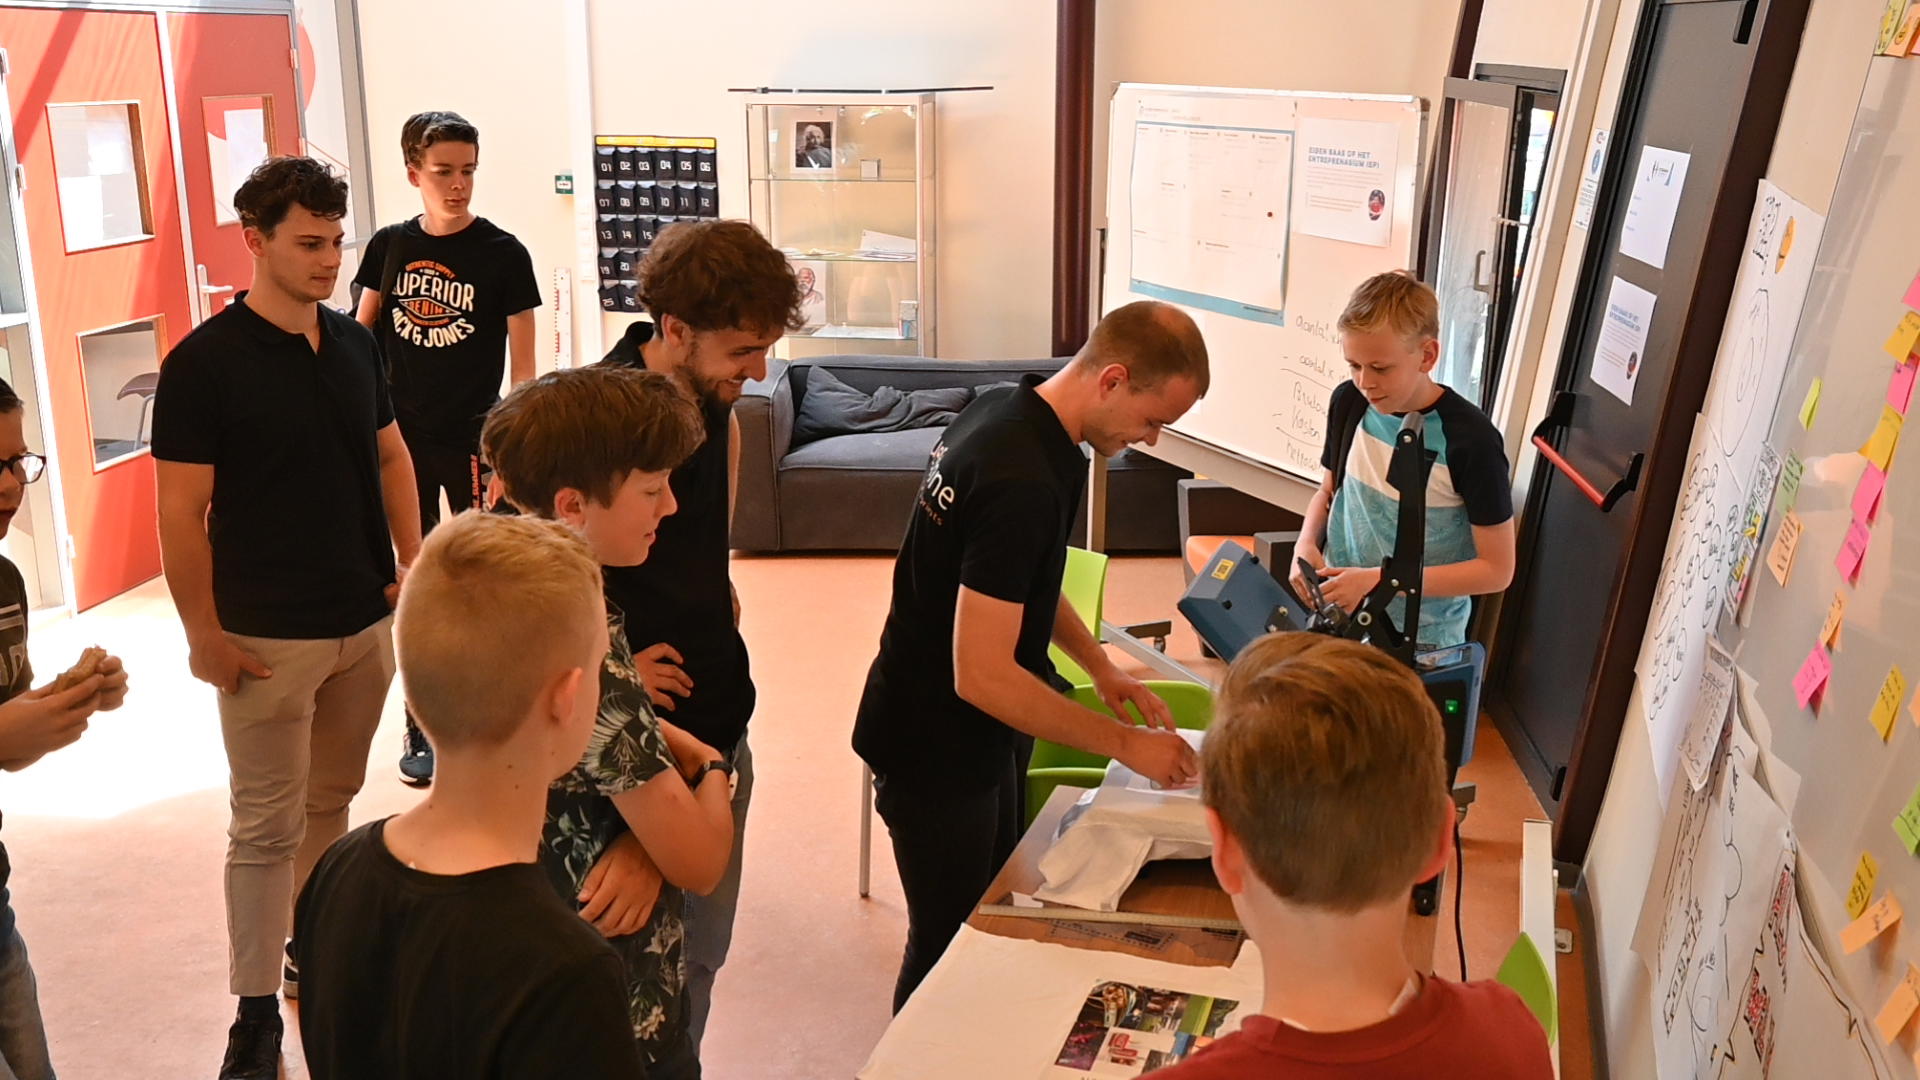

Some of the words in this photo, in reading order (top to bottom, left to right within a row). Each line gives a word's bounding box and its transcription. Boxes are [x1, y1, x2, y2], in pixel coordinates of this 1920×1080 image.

[601, 162, 612, 172] 01
[620, 161, 631, 170] 02
[638, 161, 650, 171] 03
[660, 160, 672, 170] 04
[680, 160, 692, 171] 05
[700, 162, 711, 172] 06
[599, 198, 610, 207] 07
[661, 197, 670, 207] 10
[680, 197, 689, 207] 11
[701, 197, 710, 207] 12
[601, 230, 612, 240] 13
[622, 230, 632, 240] 14
[643, 230, 653, 240] 15
[600, 265, 610, 275] 19
[620, 261, 630, 272] 20
[423, 317, 475, 347] JONES
